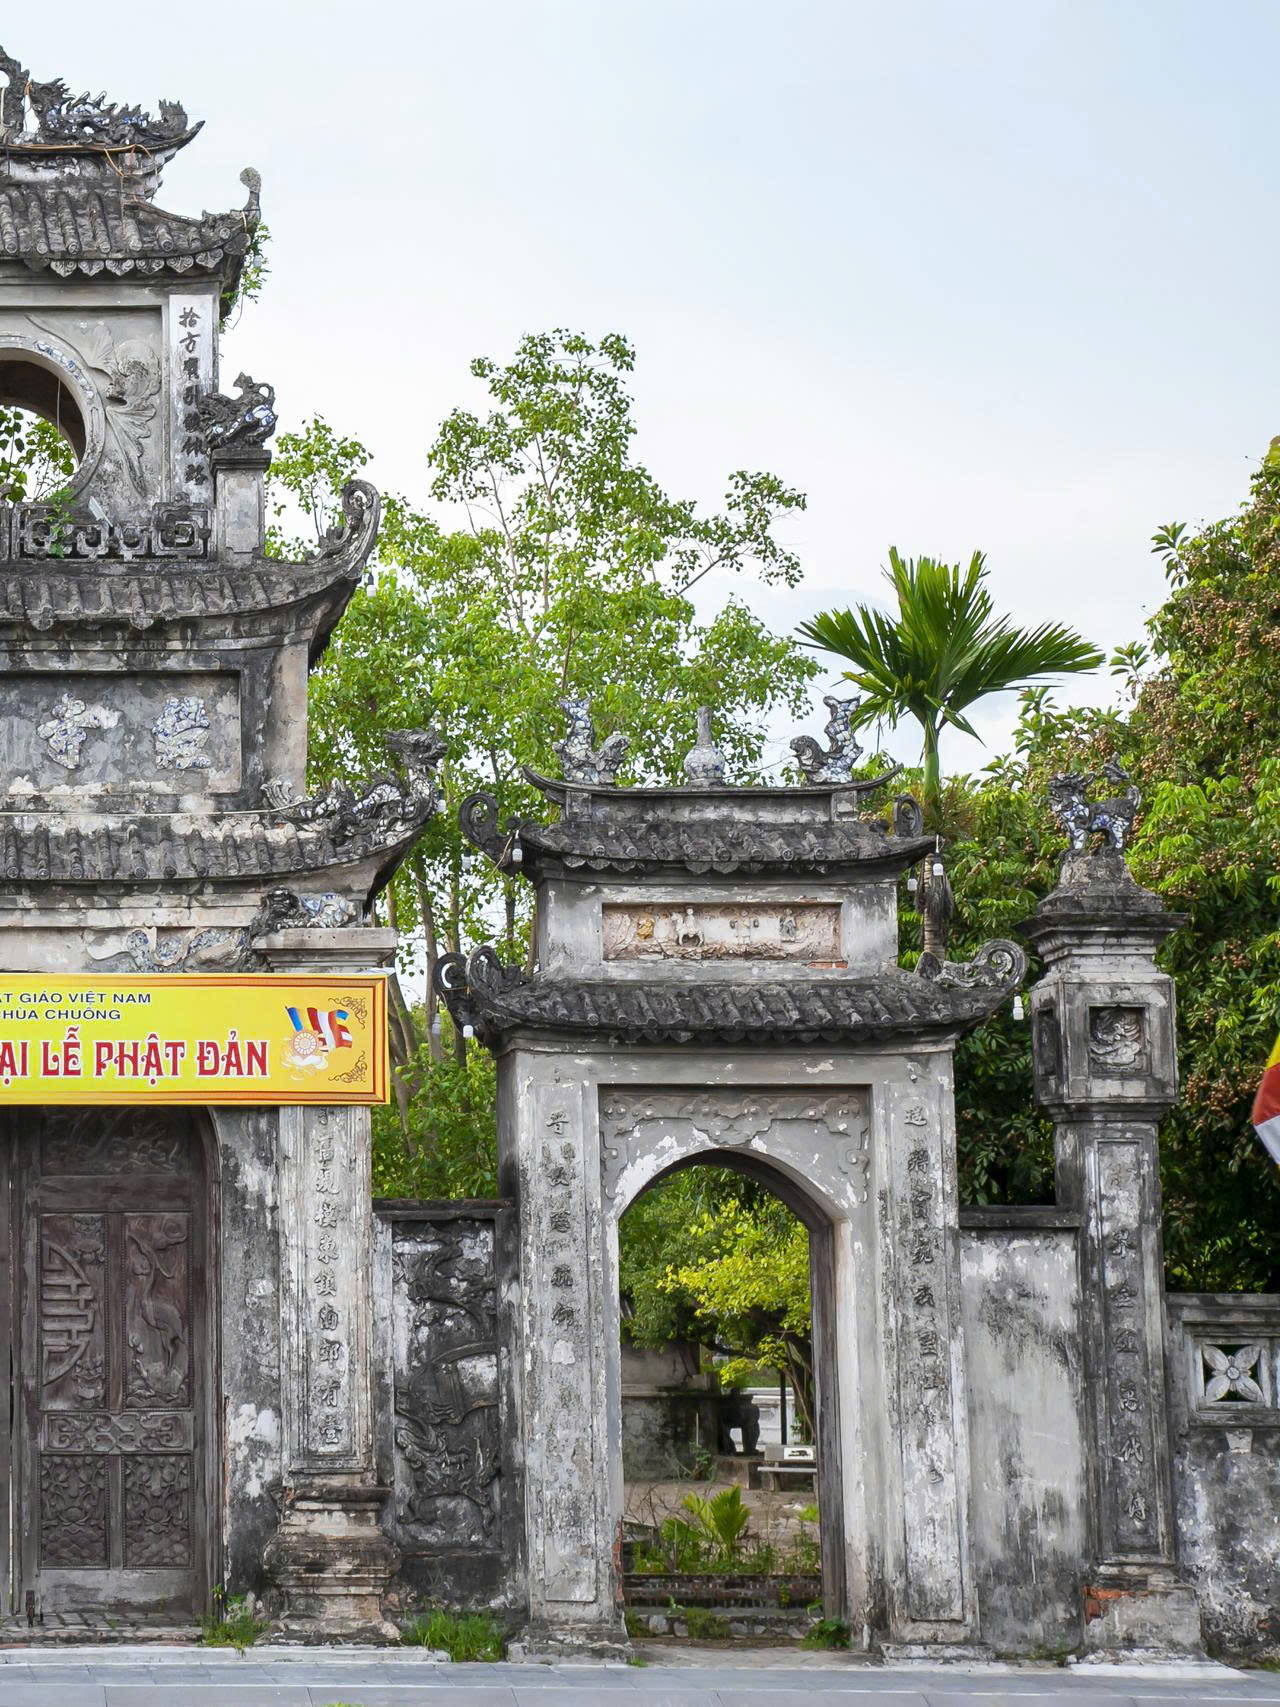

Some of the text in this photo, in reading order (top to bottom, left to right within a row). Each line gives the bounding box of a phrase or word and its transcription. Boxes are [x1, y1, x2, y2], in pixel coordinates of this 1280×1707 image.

[19, 991, 63, 1003] GIÁO
[68, 991, 107, 1005] VIỆT
[113, 993, 151, 1003] NAM
[44, 1007, 121, 1020] CHUÔNG
[42, 1027, 81, 1076] LỄ
[95, 1033, 185, 1085] PHẬT
[196, 1030, 269, 1077] ĐẢN
